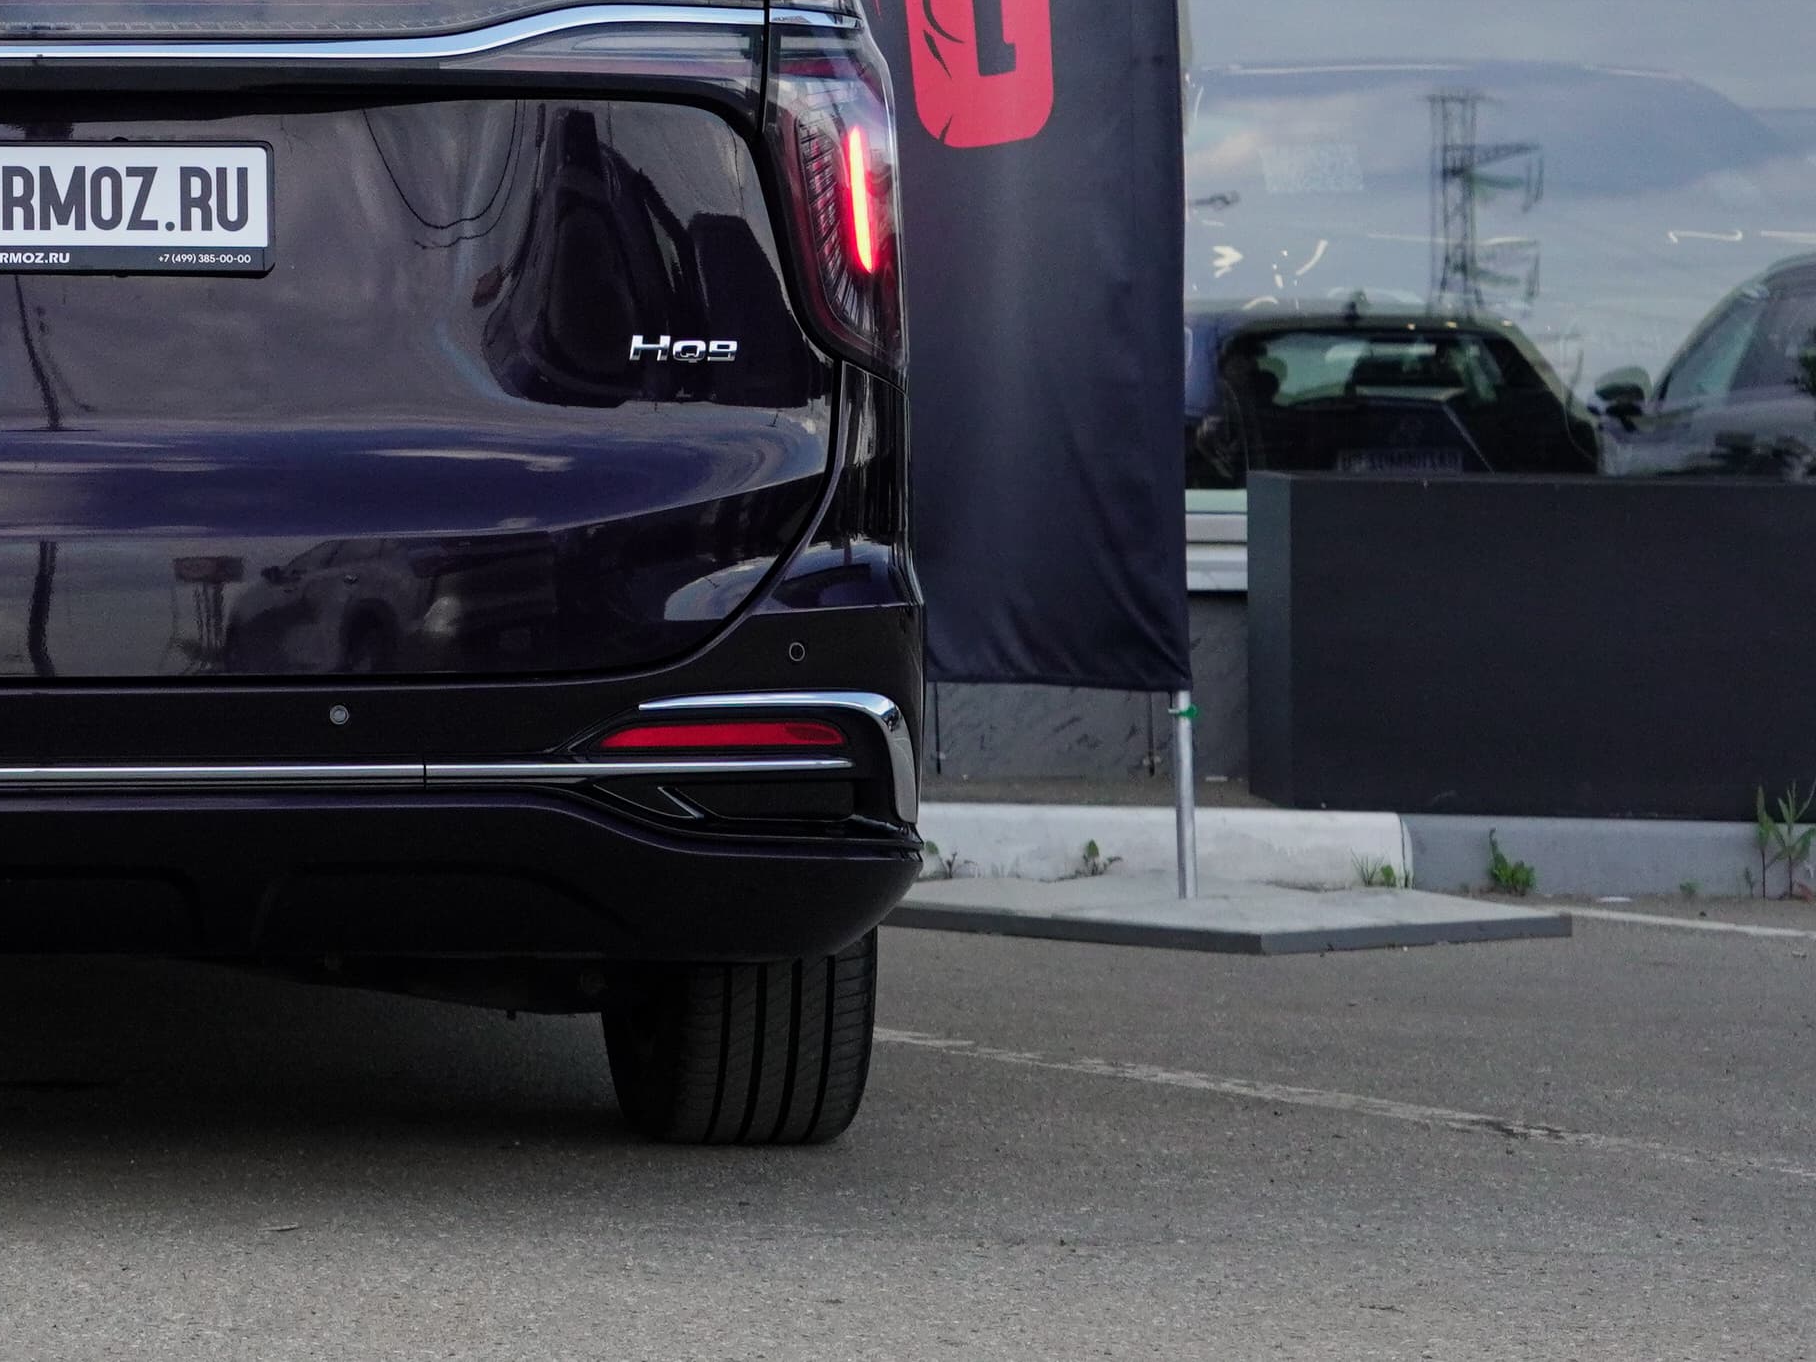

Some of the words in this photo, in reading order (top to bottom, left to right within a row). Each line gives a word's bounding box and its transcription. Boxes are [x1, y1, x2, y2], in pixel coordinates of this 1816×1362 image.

[158, 254, 170, 263] +7
[171, 253, 197, 264] (499)
[198, 254, 252, 264] 385-00-00
[629, 335, 738, 363] HQ9
